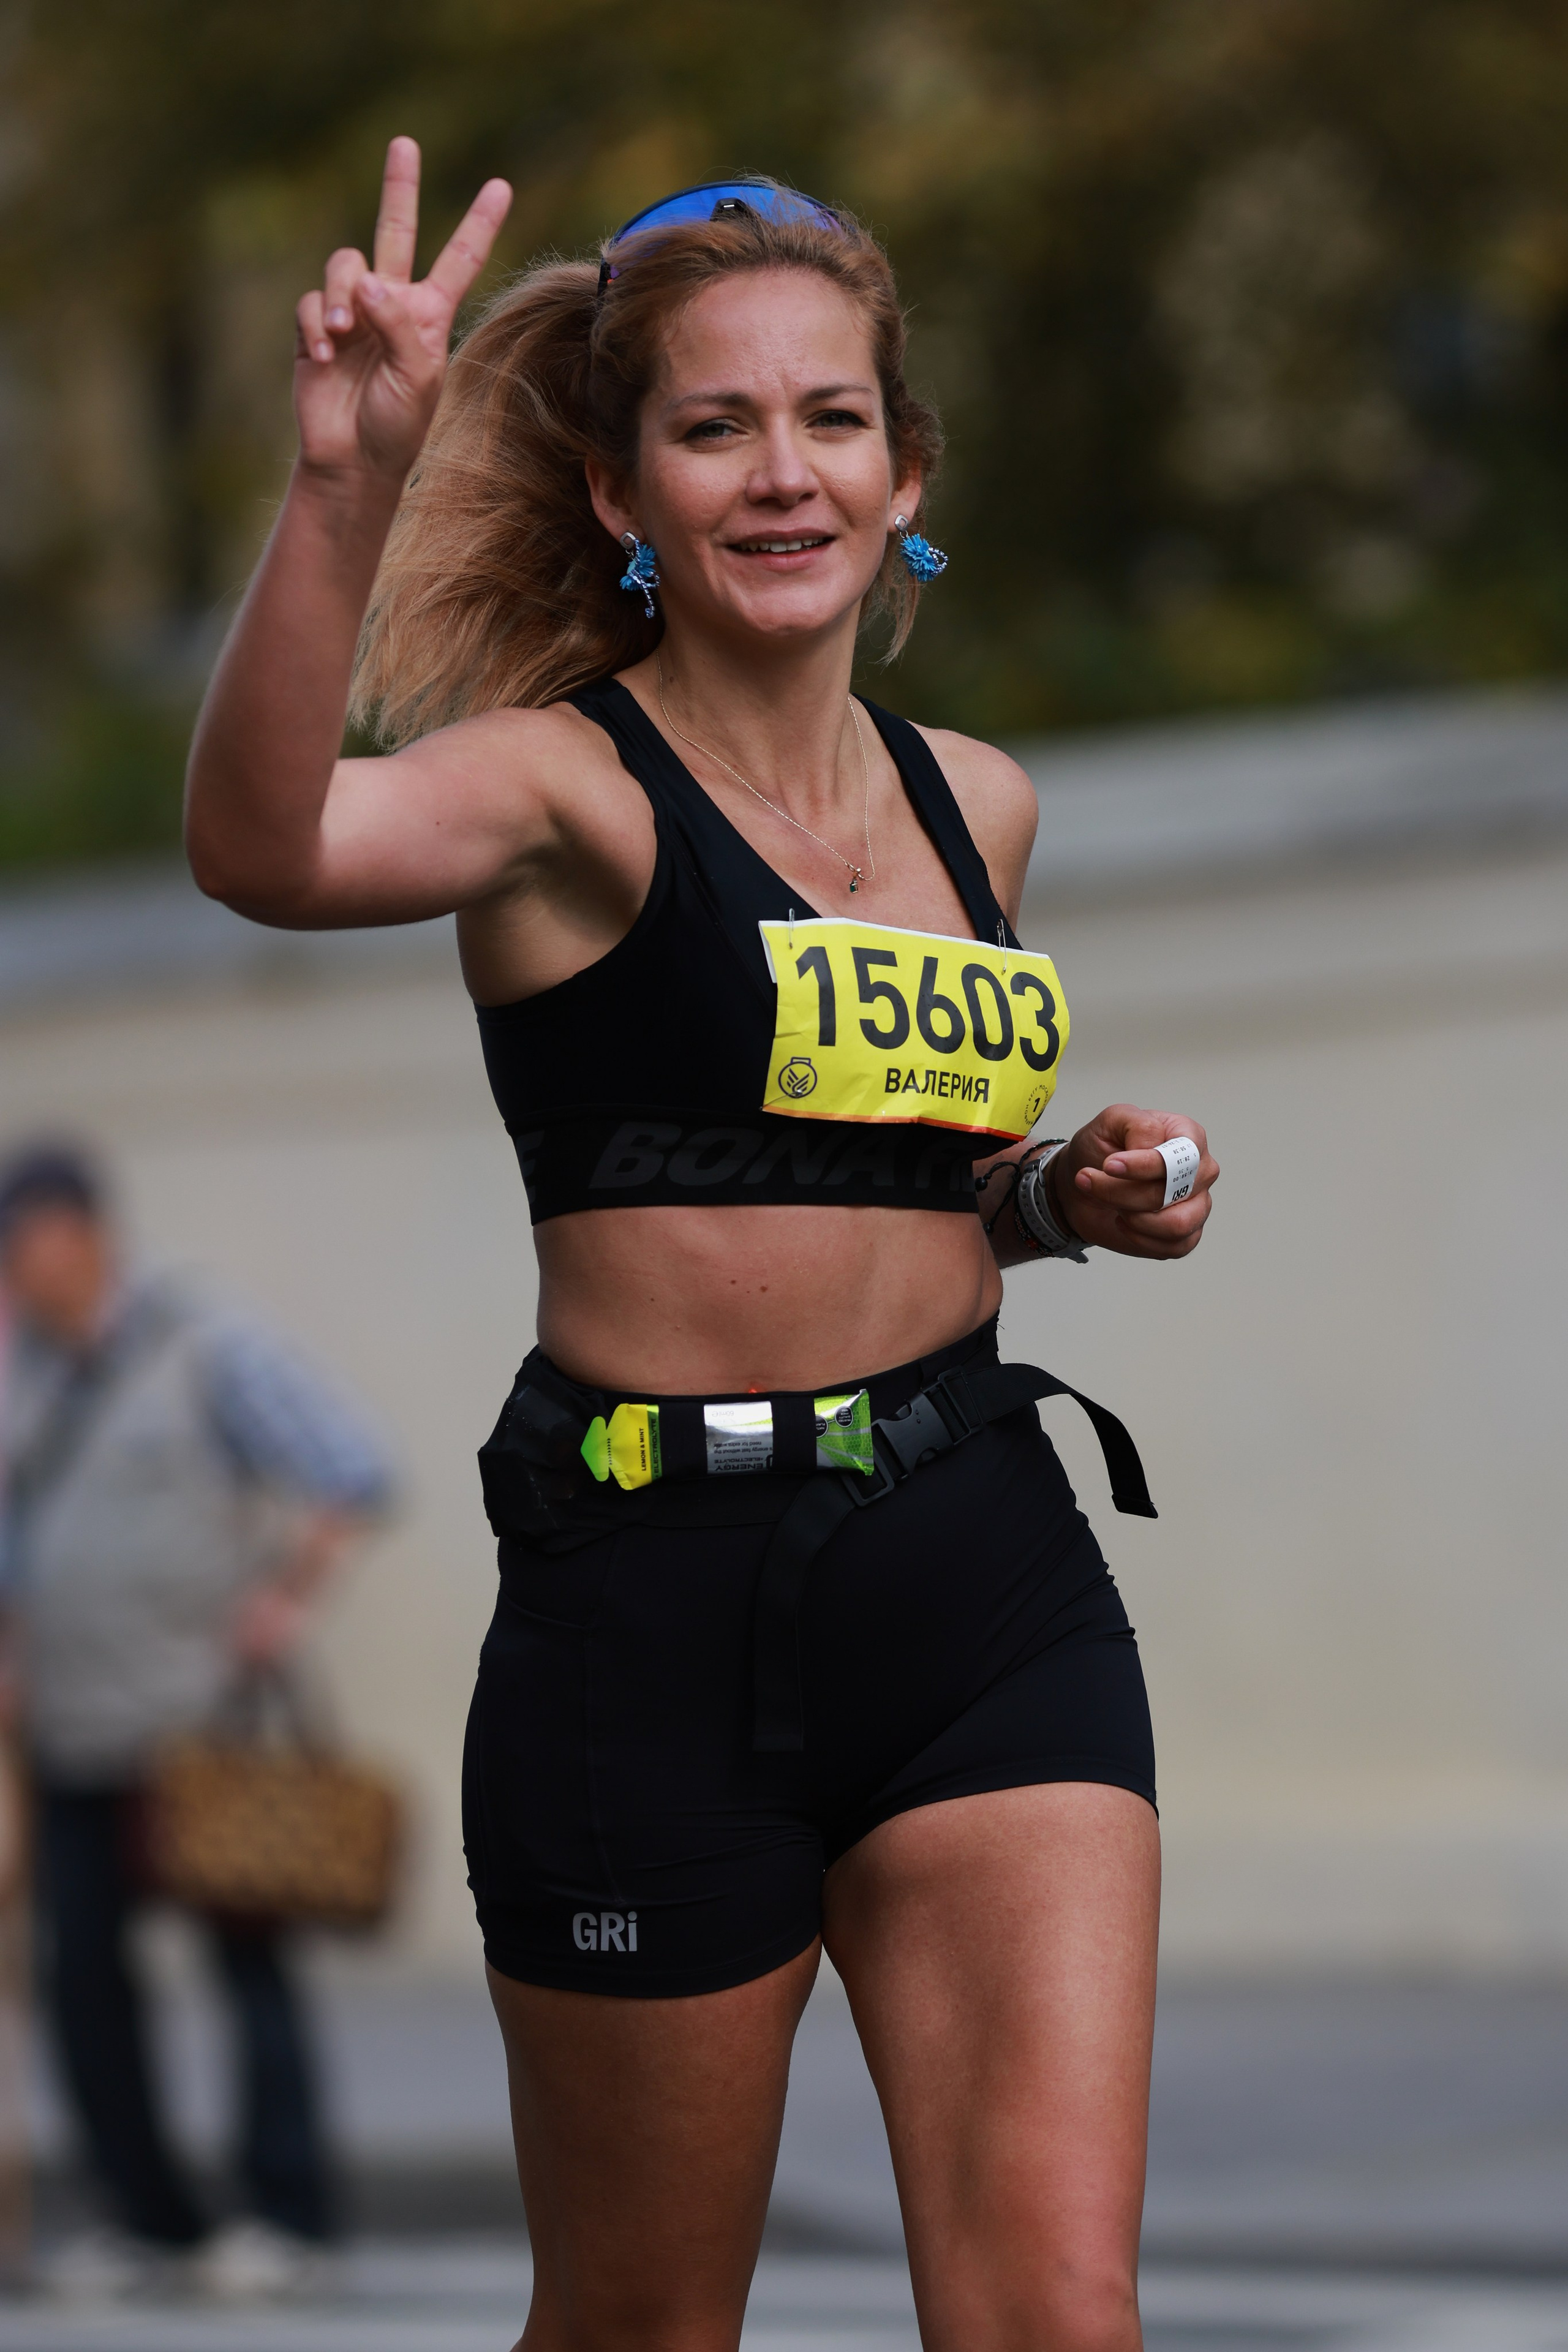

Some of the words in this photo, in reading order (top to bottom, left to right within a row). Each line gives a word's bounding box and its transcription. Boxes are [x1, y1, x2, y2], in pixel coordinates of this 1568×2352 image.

[795, 946, 1060, 1072] 15603
[884, 1068, 990, 1104] ВАЛЕРИЯ
[1033, 1097, 1041, 1113] 1
[587, 1120, 895, 1189] BONA
[650, 1418, 659, 1474] ELECTROLYTE
[573, 1911, 638, 1952] GRi
